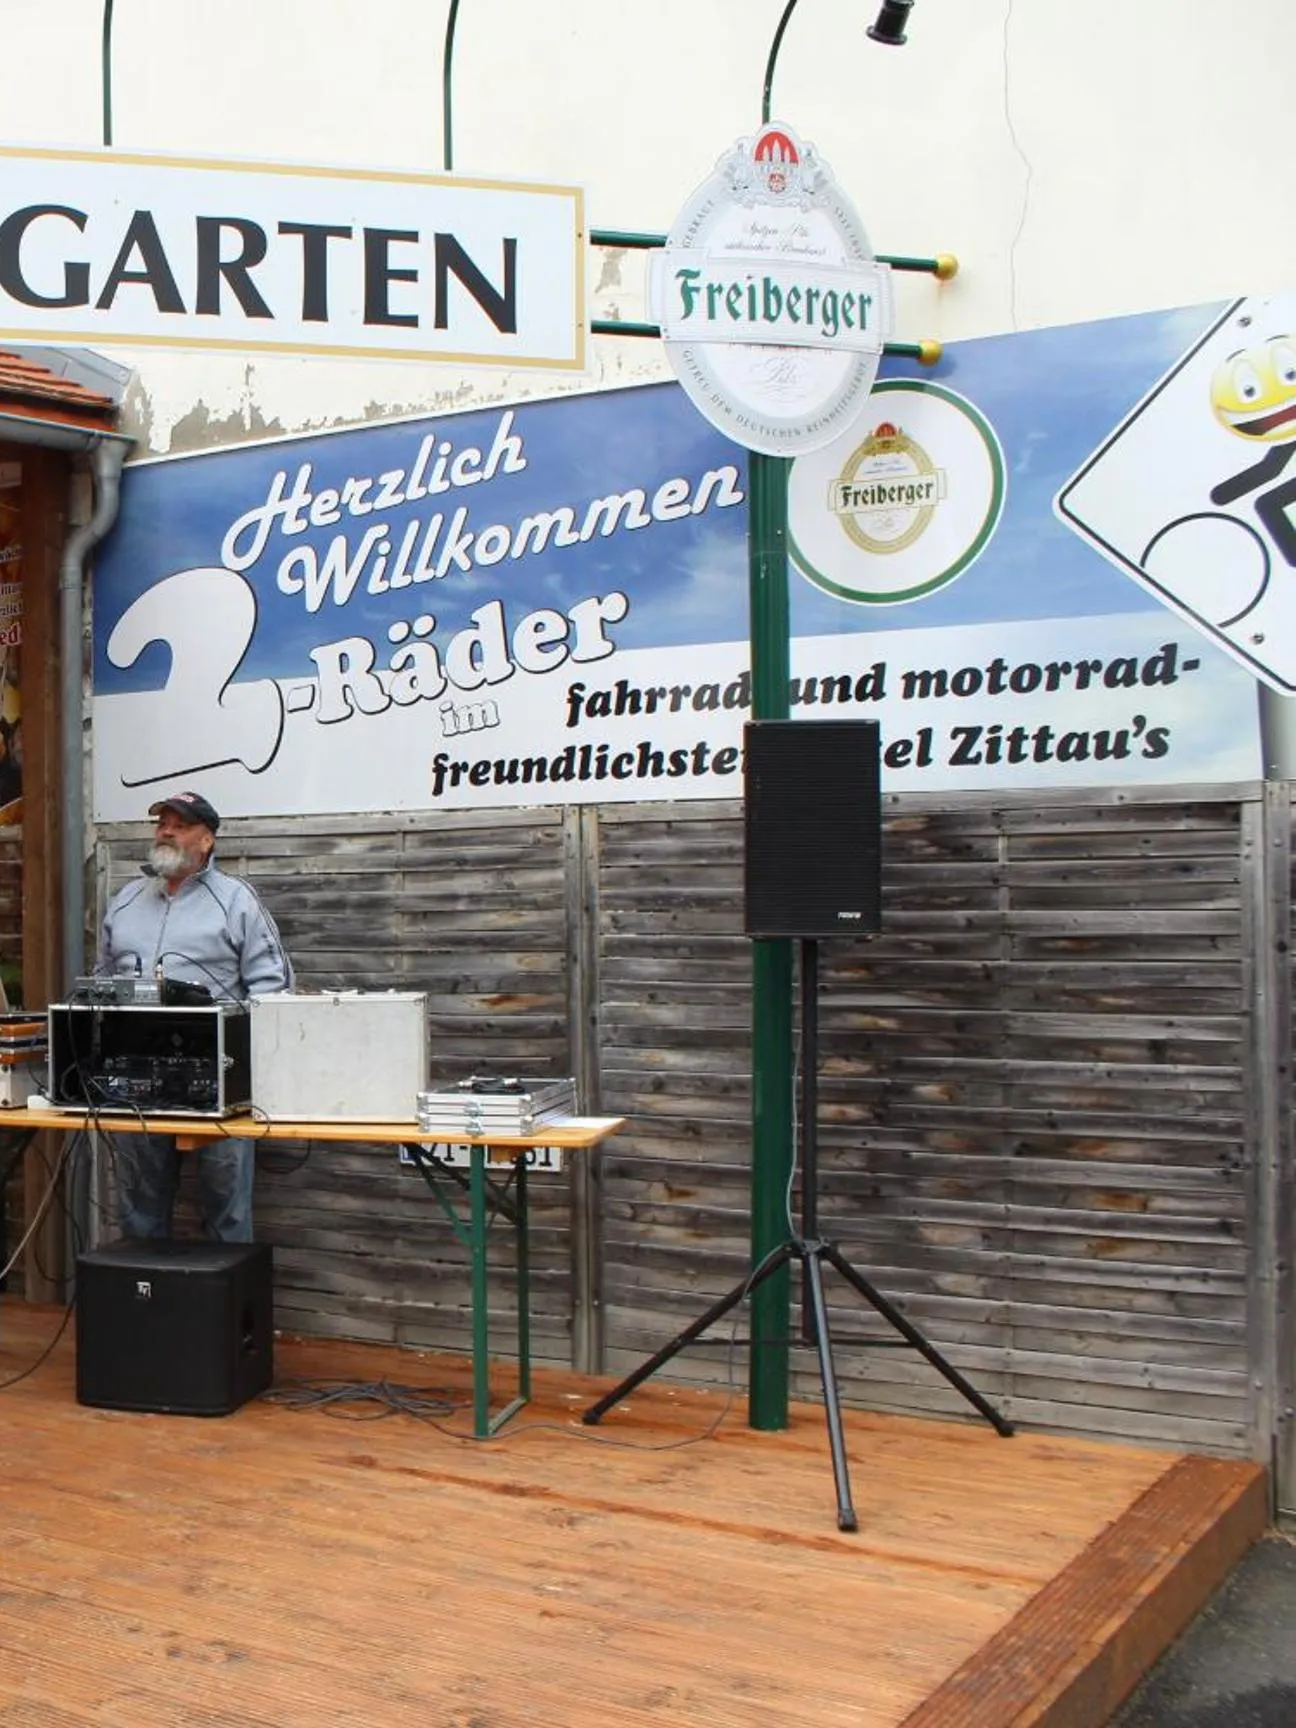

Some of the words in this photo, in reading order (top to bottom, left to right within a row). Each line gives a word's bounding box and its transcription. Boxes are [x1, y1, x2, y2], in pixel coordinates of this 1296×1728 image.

[675, 268, 873, 337] Freiberger
[735, 414, 802, 439] DEUTSCHEN
[221, 410, 526, 573] Herzlich
[840, 482, 935, 508] Freiberger
[277, 464, 746, 613] Willkommen
[790, 661, 887, 706] und
[901, 642, 1202, 698] motorrad-
[439, 697, 501, 738] im
[948, 714, 1173, 768] Zittau's
